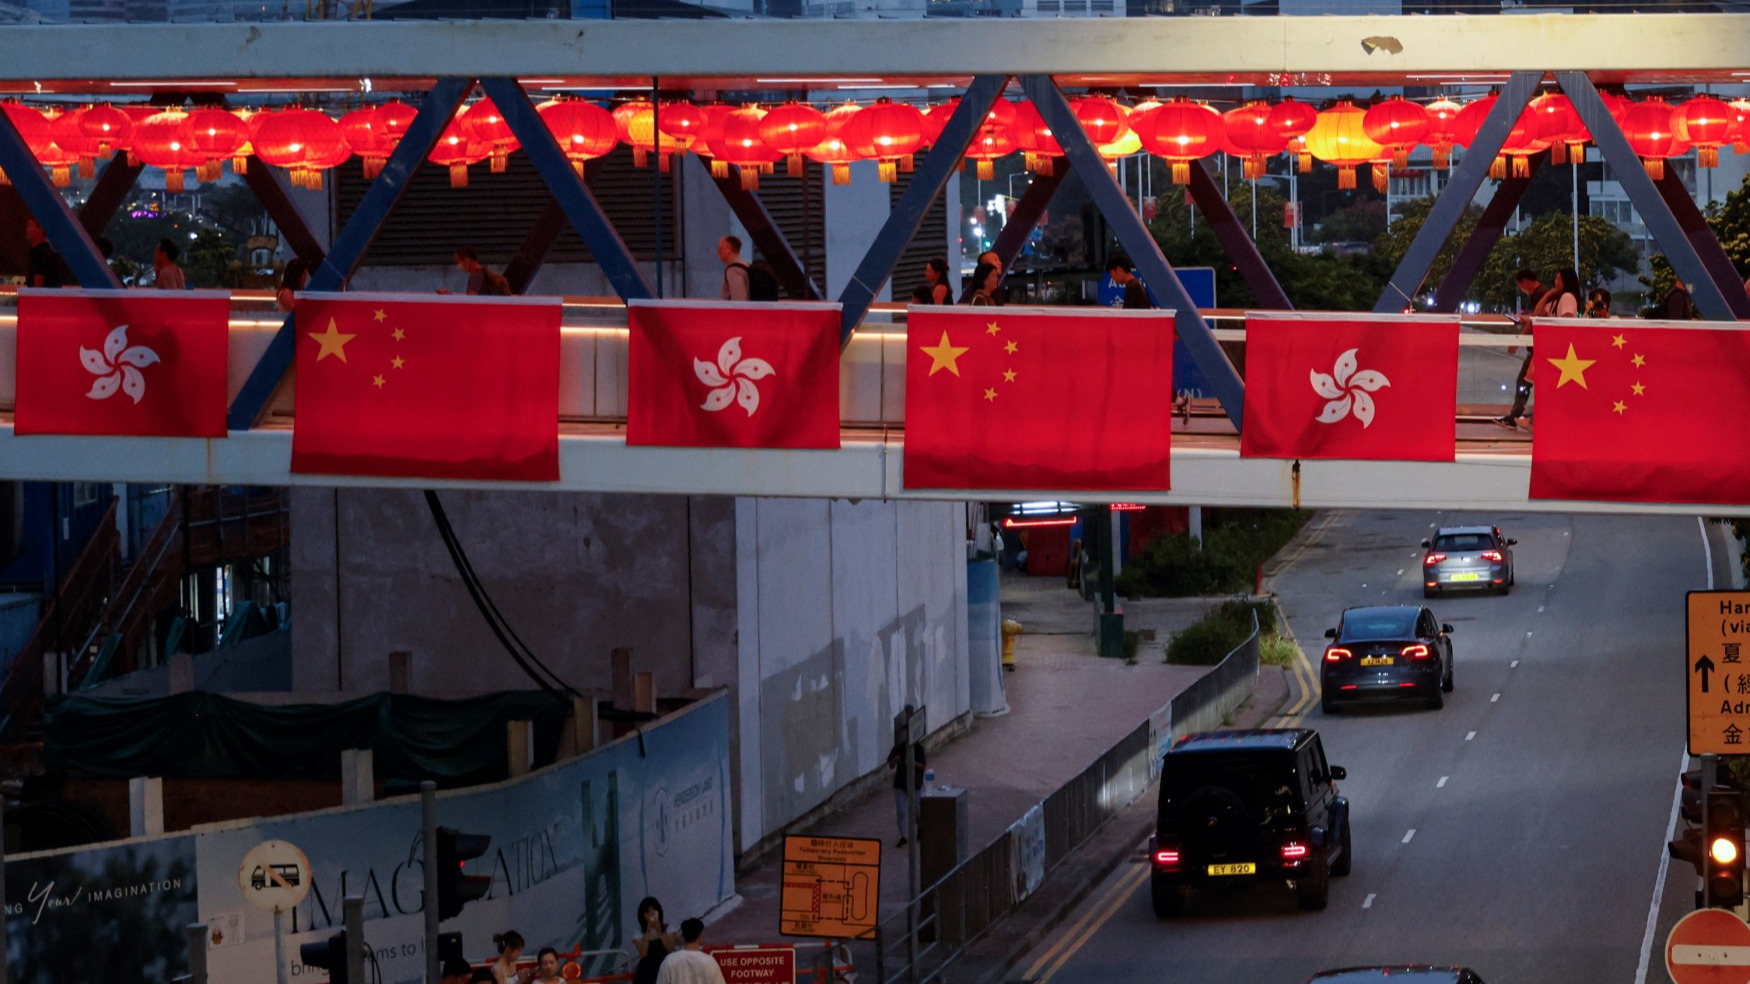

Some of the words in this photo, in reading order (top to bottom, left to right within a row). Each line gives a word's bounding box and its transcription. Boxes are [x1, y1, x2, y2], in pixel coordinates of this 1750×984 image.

[799, 847, 832, 856] Temporary
[1213, 865, 1225, 874] EY
[88, 878, 182, 903] IMAGINATION
[402, 943, 416, 957] to
[720, 958, 739, 967] USE
[740, 956, 785, 966] OPPOSITE
[730, 968, 775, 979] FOOTWAY
